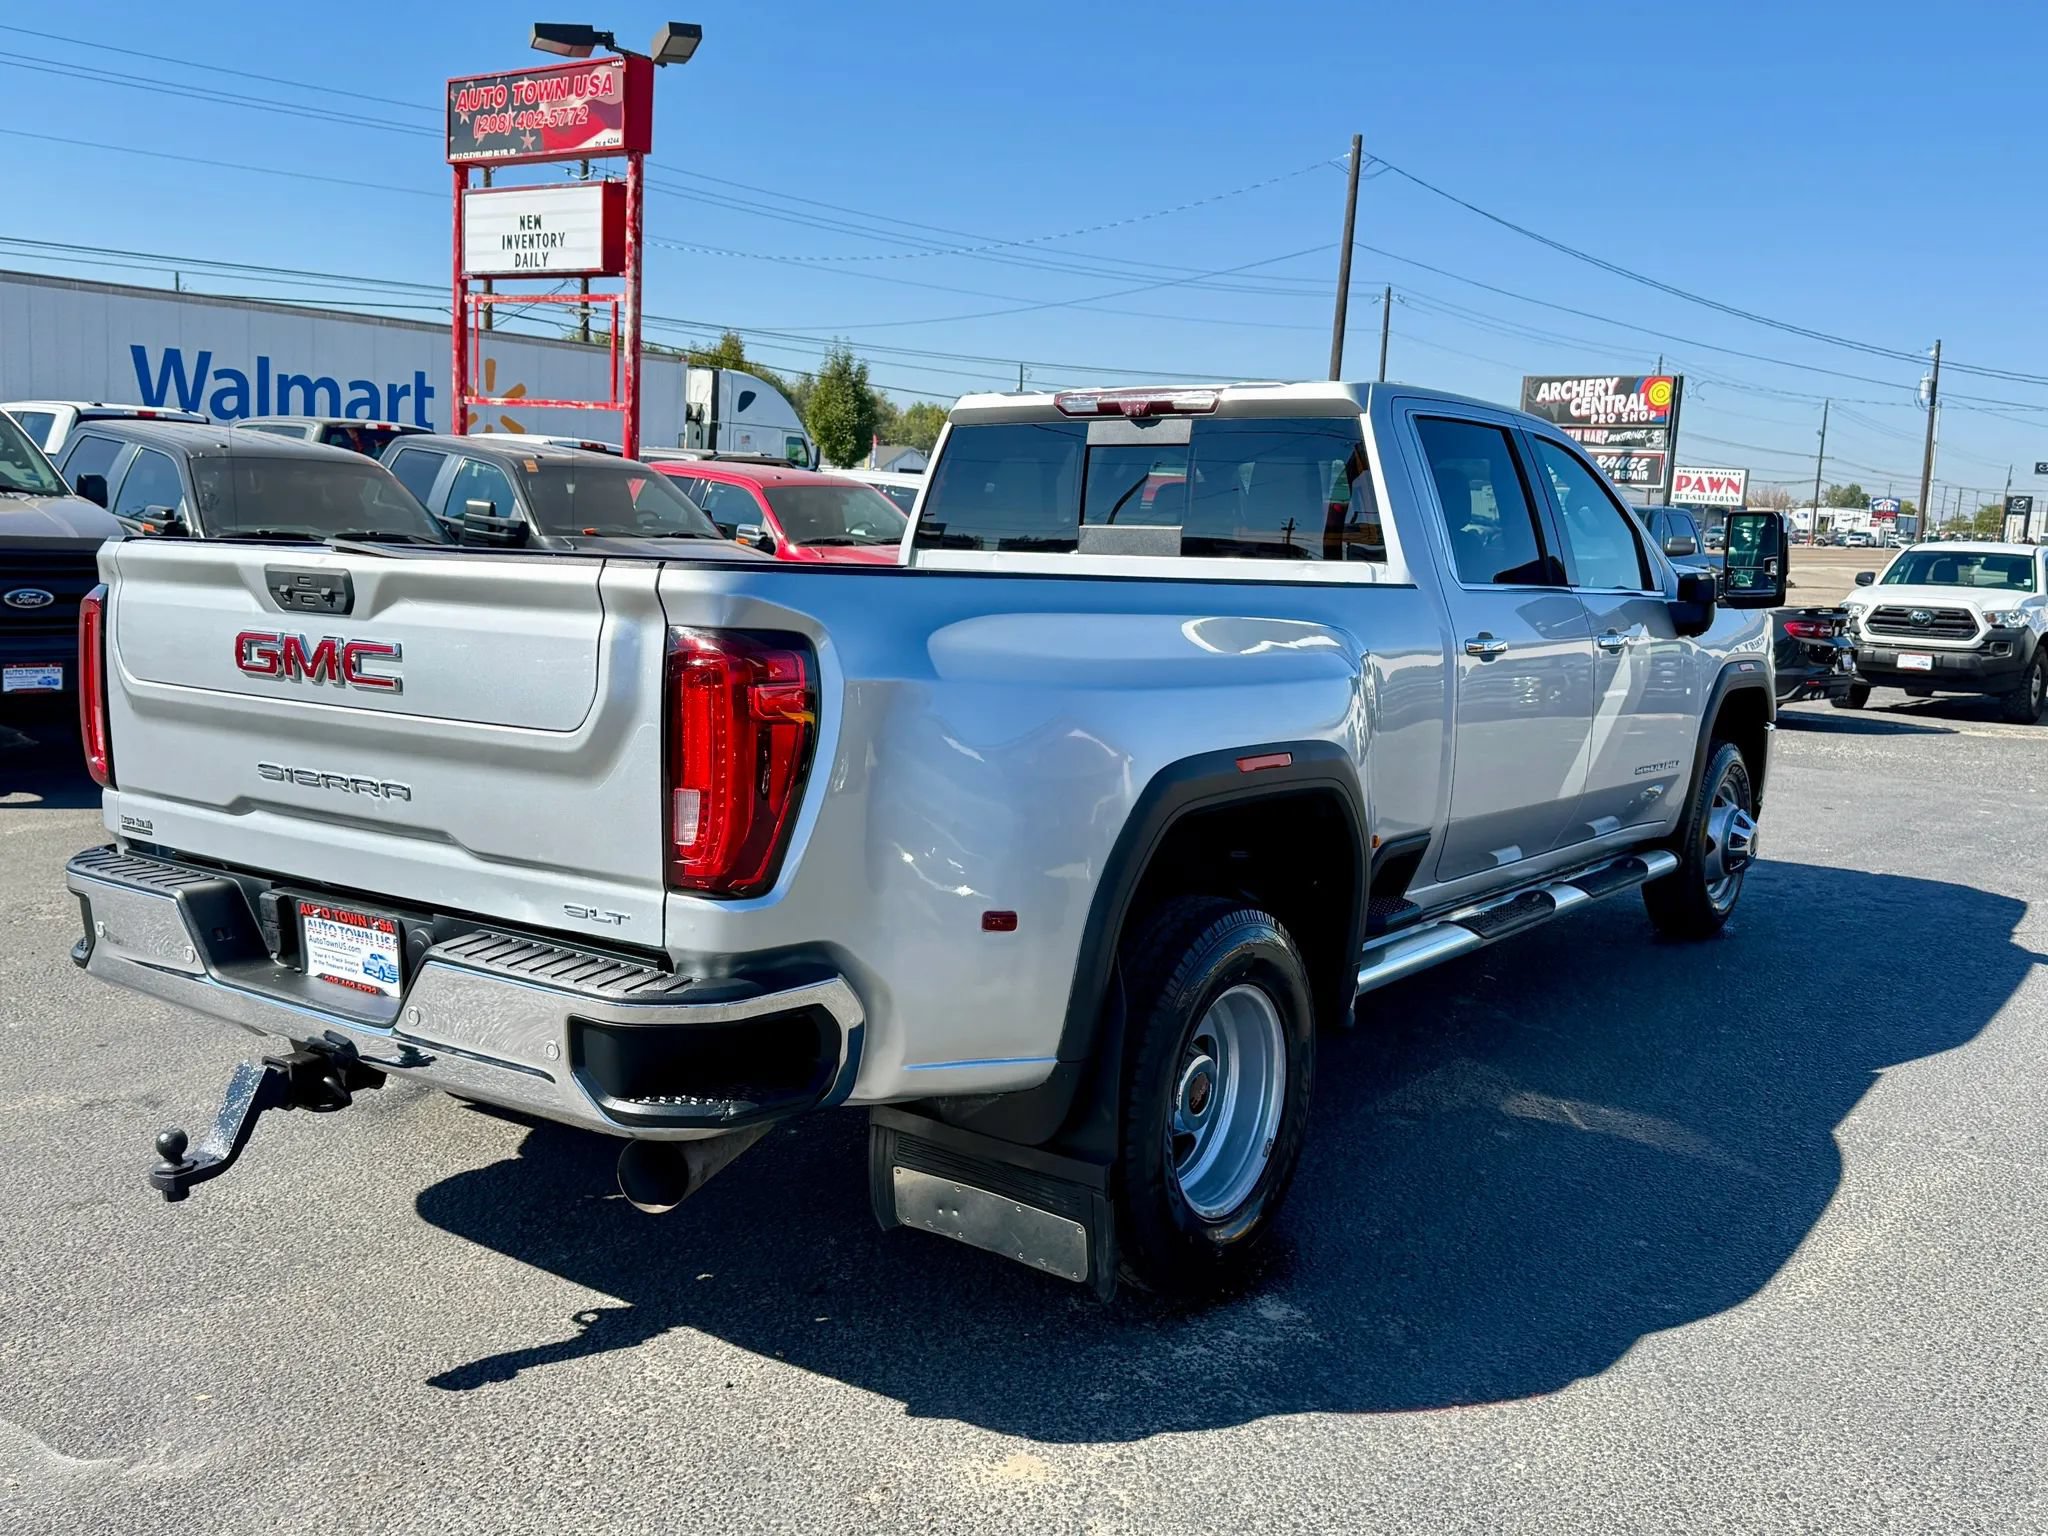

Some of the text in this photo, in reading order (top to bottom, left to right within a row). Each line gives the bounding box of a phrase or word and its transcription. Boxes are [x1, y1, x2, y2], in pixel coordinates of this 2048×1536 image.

[455, 72, 614, 112] AUTO TOWN USA
[473, 104, 589, 138] (208) 402-5772
[519, 214, 542, 231] NEW
[502, 232, 566, 250] INVENTORY
[514, 252, 549, 268] DAILY
[130, 344, 434, 430] Walmart
[1536, 377, 1620, 402] ARCHERY
[1570, 393, 1648, 417] CENTRAL
[1590, 410, 1657, 424] PRO SHOP
[1596, 455, 1650, 471] RANGE
[1614, 470, 1649, 480] REPAIR
[1675, 475, 1741, 495] PAWN
[16, 592, 43, 605] Ford
[235, 629, 404, 695] GMC
[257, 760, 412, 802] SIERRA
[332, 909, 367, 926] TOWN
[563, 904, 631, 926] SLT
